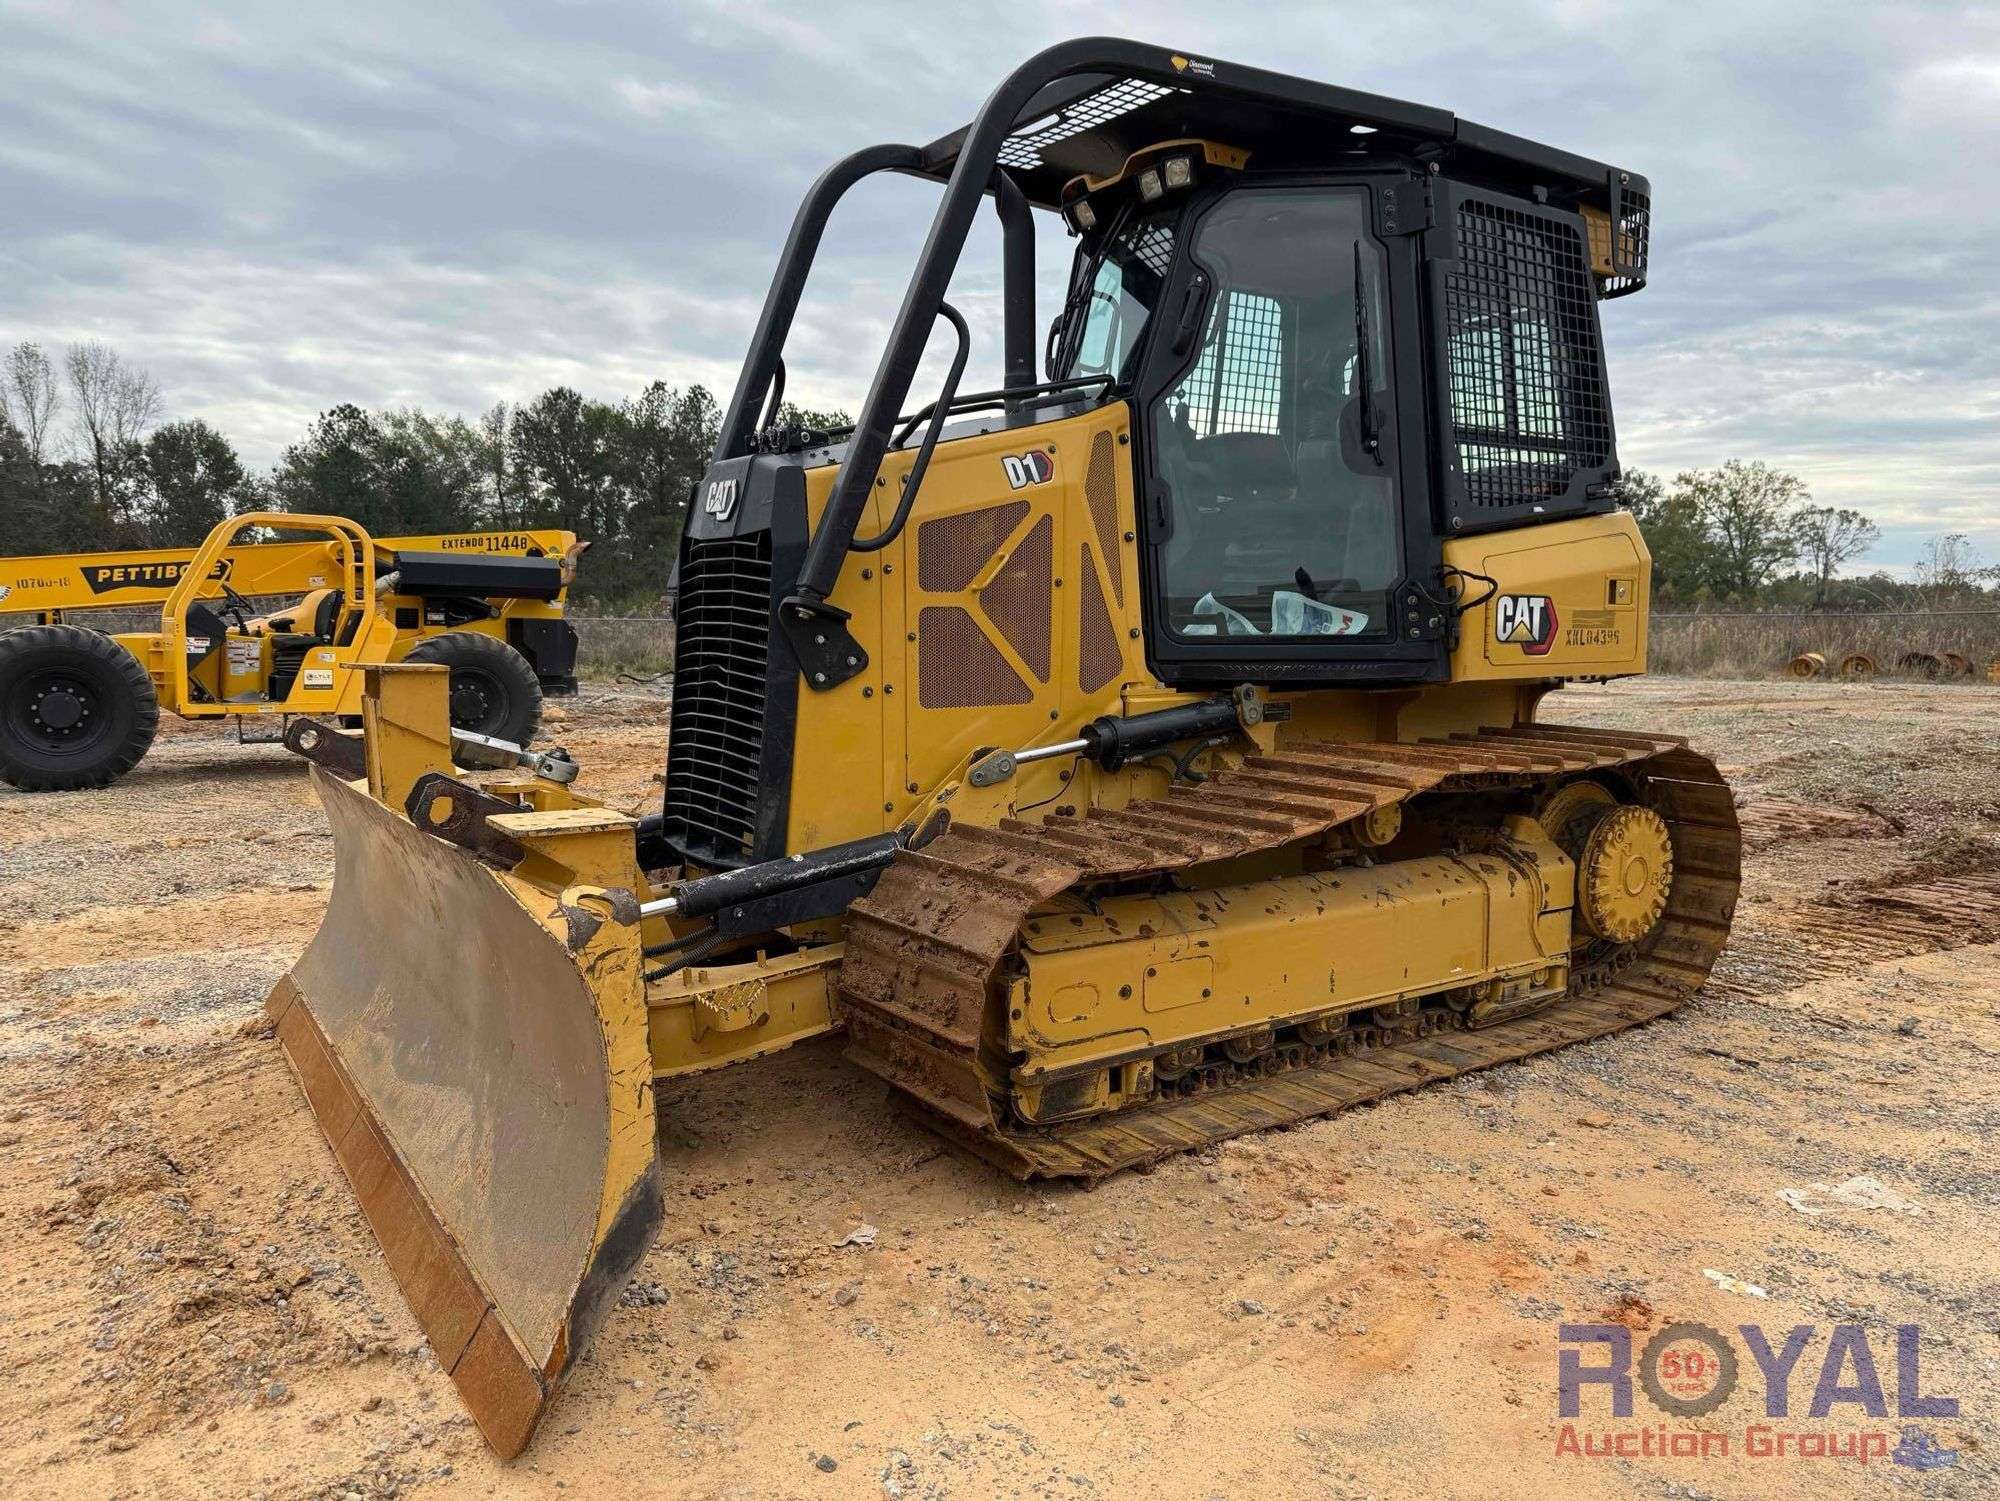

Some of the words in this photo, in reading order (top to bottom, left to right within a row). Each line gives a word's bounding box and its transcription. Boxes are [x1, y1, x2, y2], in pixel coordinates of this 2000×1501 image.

[1001, 453, 1041, 489] D1
[705, 479, 732, 513] CAT
[486, 536, 528, 551] 1144B
[97, 562, 221, 583] PETTIBE
[1496, 595, 1545, 642] CAT
